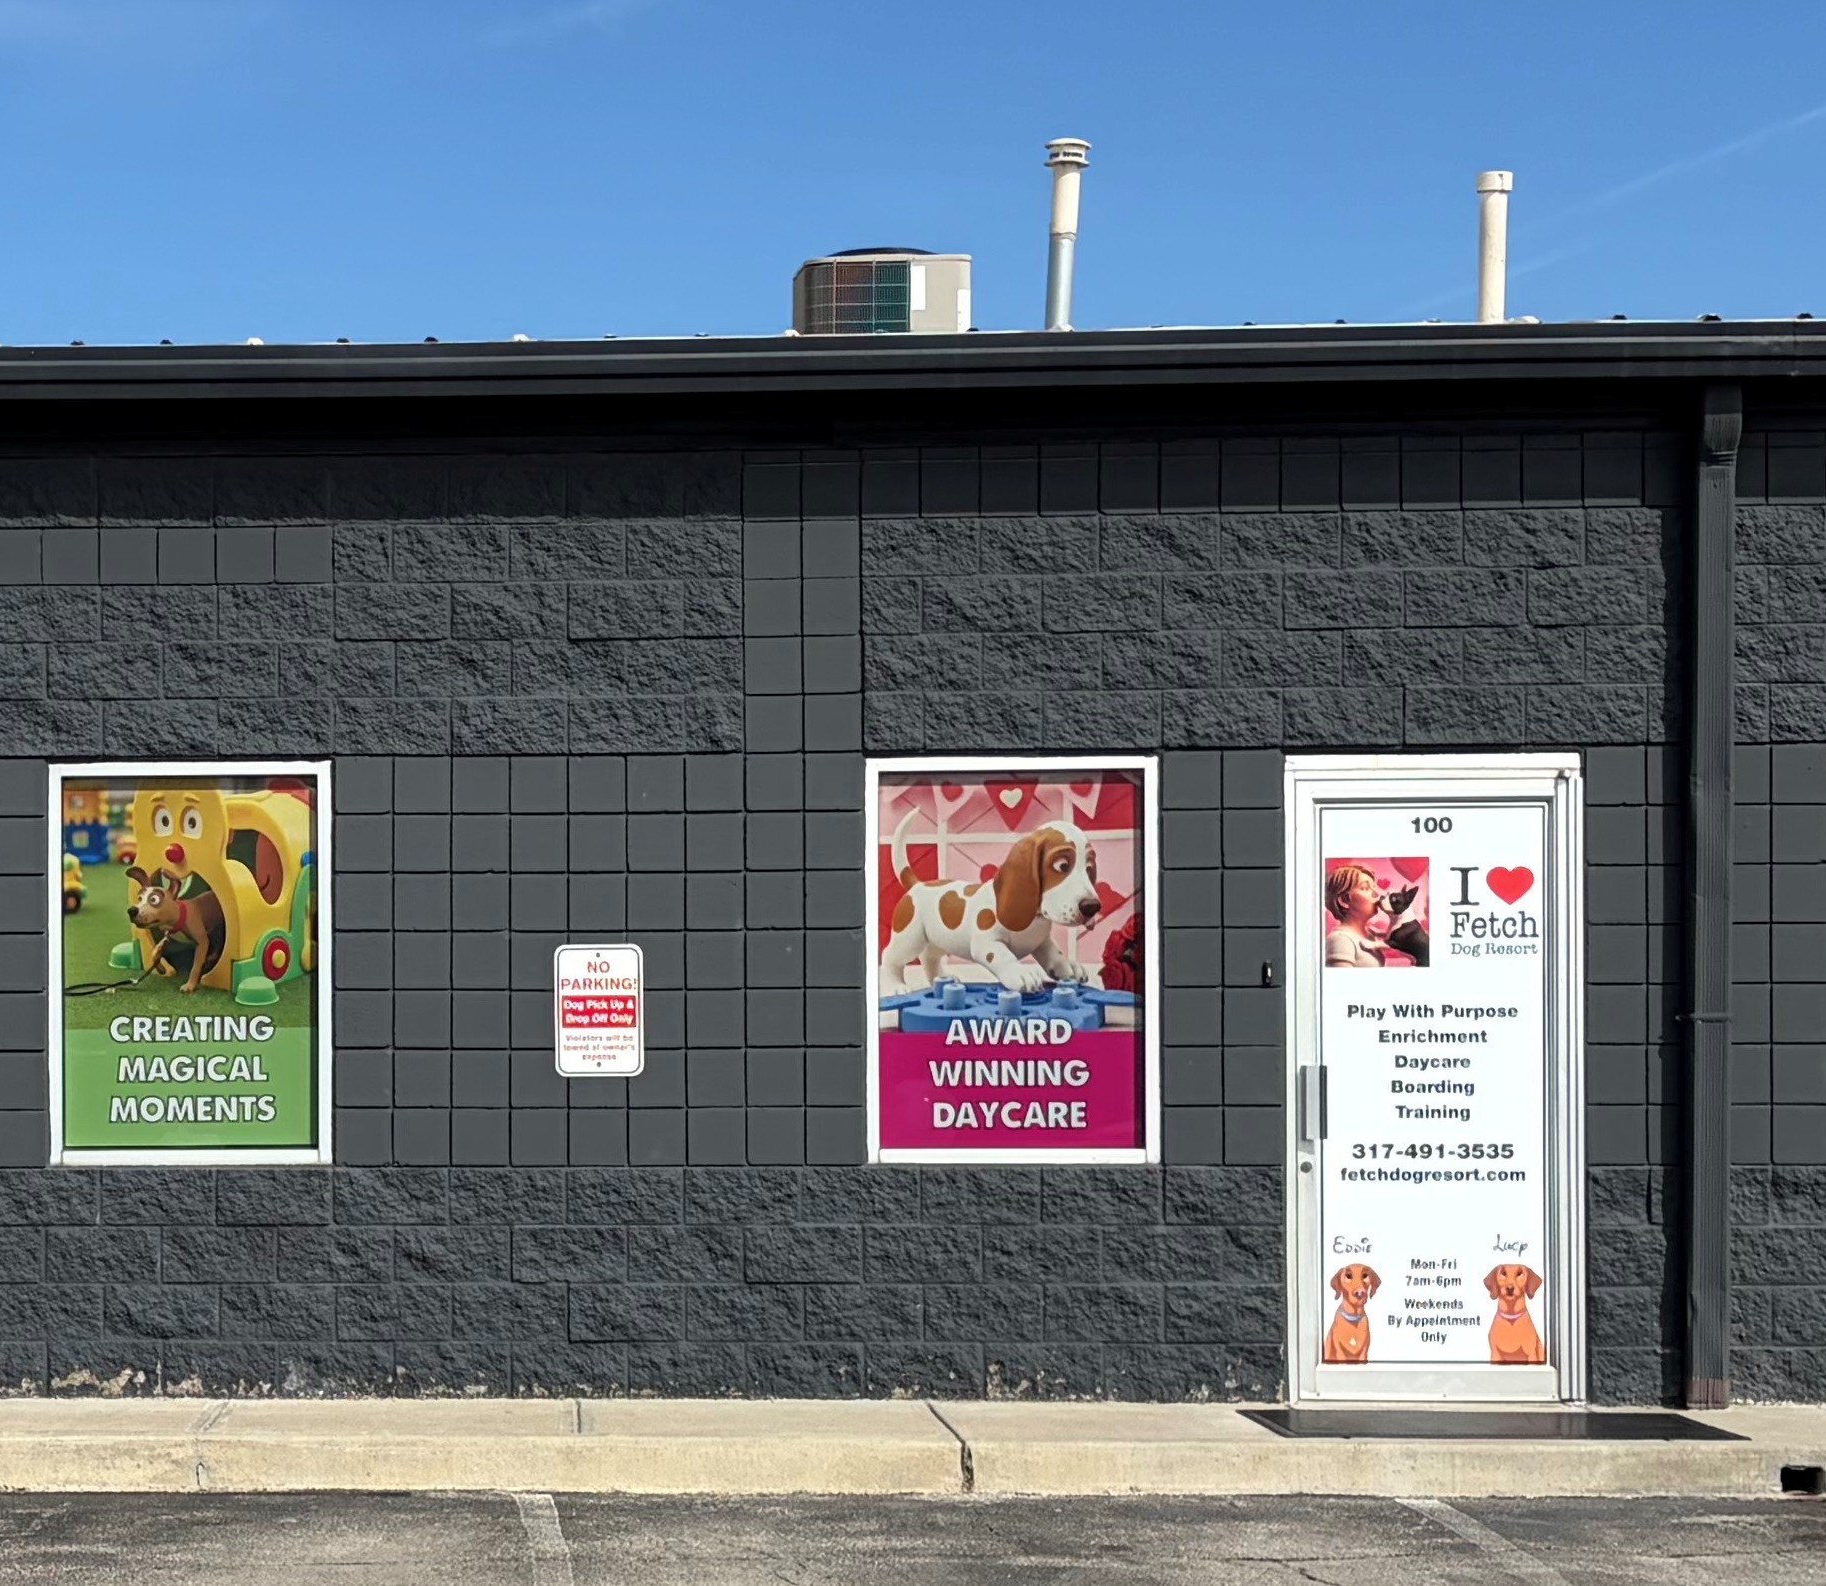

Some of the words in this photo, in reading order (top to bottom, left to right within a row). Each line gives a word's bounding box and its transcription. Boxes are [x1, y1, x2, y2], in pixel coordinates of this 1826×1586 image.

[1410, 816, 1453, 834] 100
[1449, 866, 1480, 906] I
[1449, 910, 1540, 939] Fetch
[1450, 942, 1481, 958] Dog
[1485, 942, 1538, 955] Resort
[587, 960, 611, 973] NO
[561, 977, 638, 991] PARKING!
[564, 999, 585, 1011] Dog
[586, 999, 609, 1009] Pick
[609, 999, 625, 1011] Up
[626, 999, 634, 1009] &
[1347, 1004, 1387, 1022] Play
[1392, 1003, 1435, 1019] With
[1441, 1004, 1519, 1021] Purpose
[565, 1013, 590, 1024] Drop
[591, 1013, 609, 1024] Off
[609, 1013, 634, 1025] Only
[109, 1014, 275, 1043] CREATING
[944, 1017, 1073, 1046] AWARD
[1378, 1028, 1488, 1044] Enrichment
[117, 1055, 268, 1083] MAGICAL
[1394, 1054, 1471, 1072] Daycare
[927, 1058, 1091, 1088] WINNING
[1390, 1079, 1475, 1097] Boarding
[109, 1095, 277, 1123] MOMENTS
[932, 1100, 1088, 1129] DAYCARE
[1394, 1104, 1471, 1122] Training
[1352, 1143, 1515, 1160] 317-491-3535
[1340, 1166, 1526, 1184] fetchdogresort.com
[1410, 1258, 1457, 1271] Mon-Fri
[1405, 1275, 1462, 1289] 7am-6pm
[1404, 1298, 1464, 1310] Weekends
[1387, 1314, 1403, 1328] By
[1406, 1314, 1481, 1328] Appointment
[1420, 1331, 1448, 1345] Only
